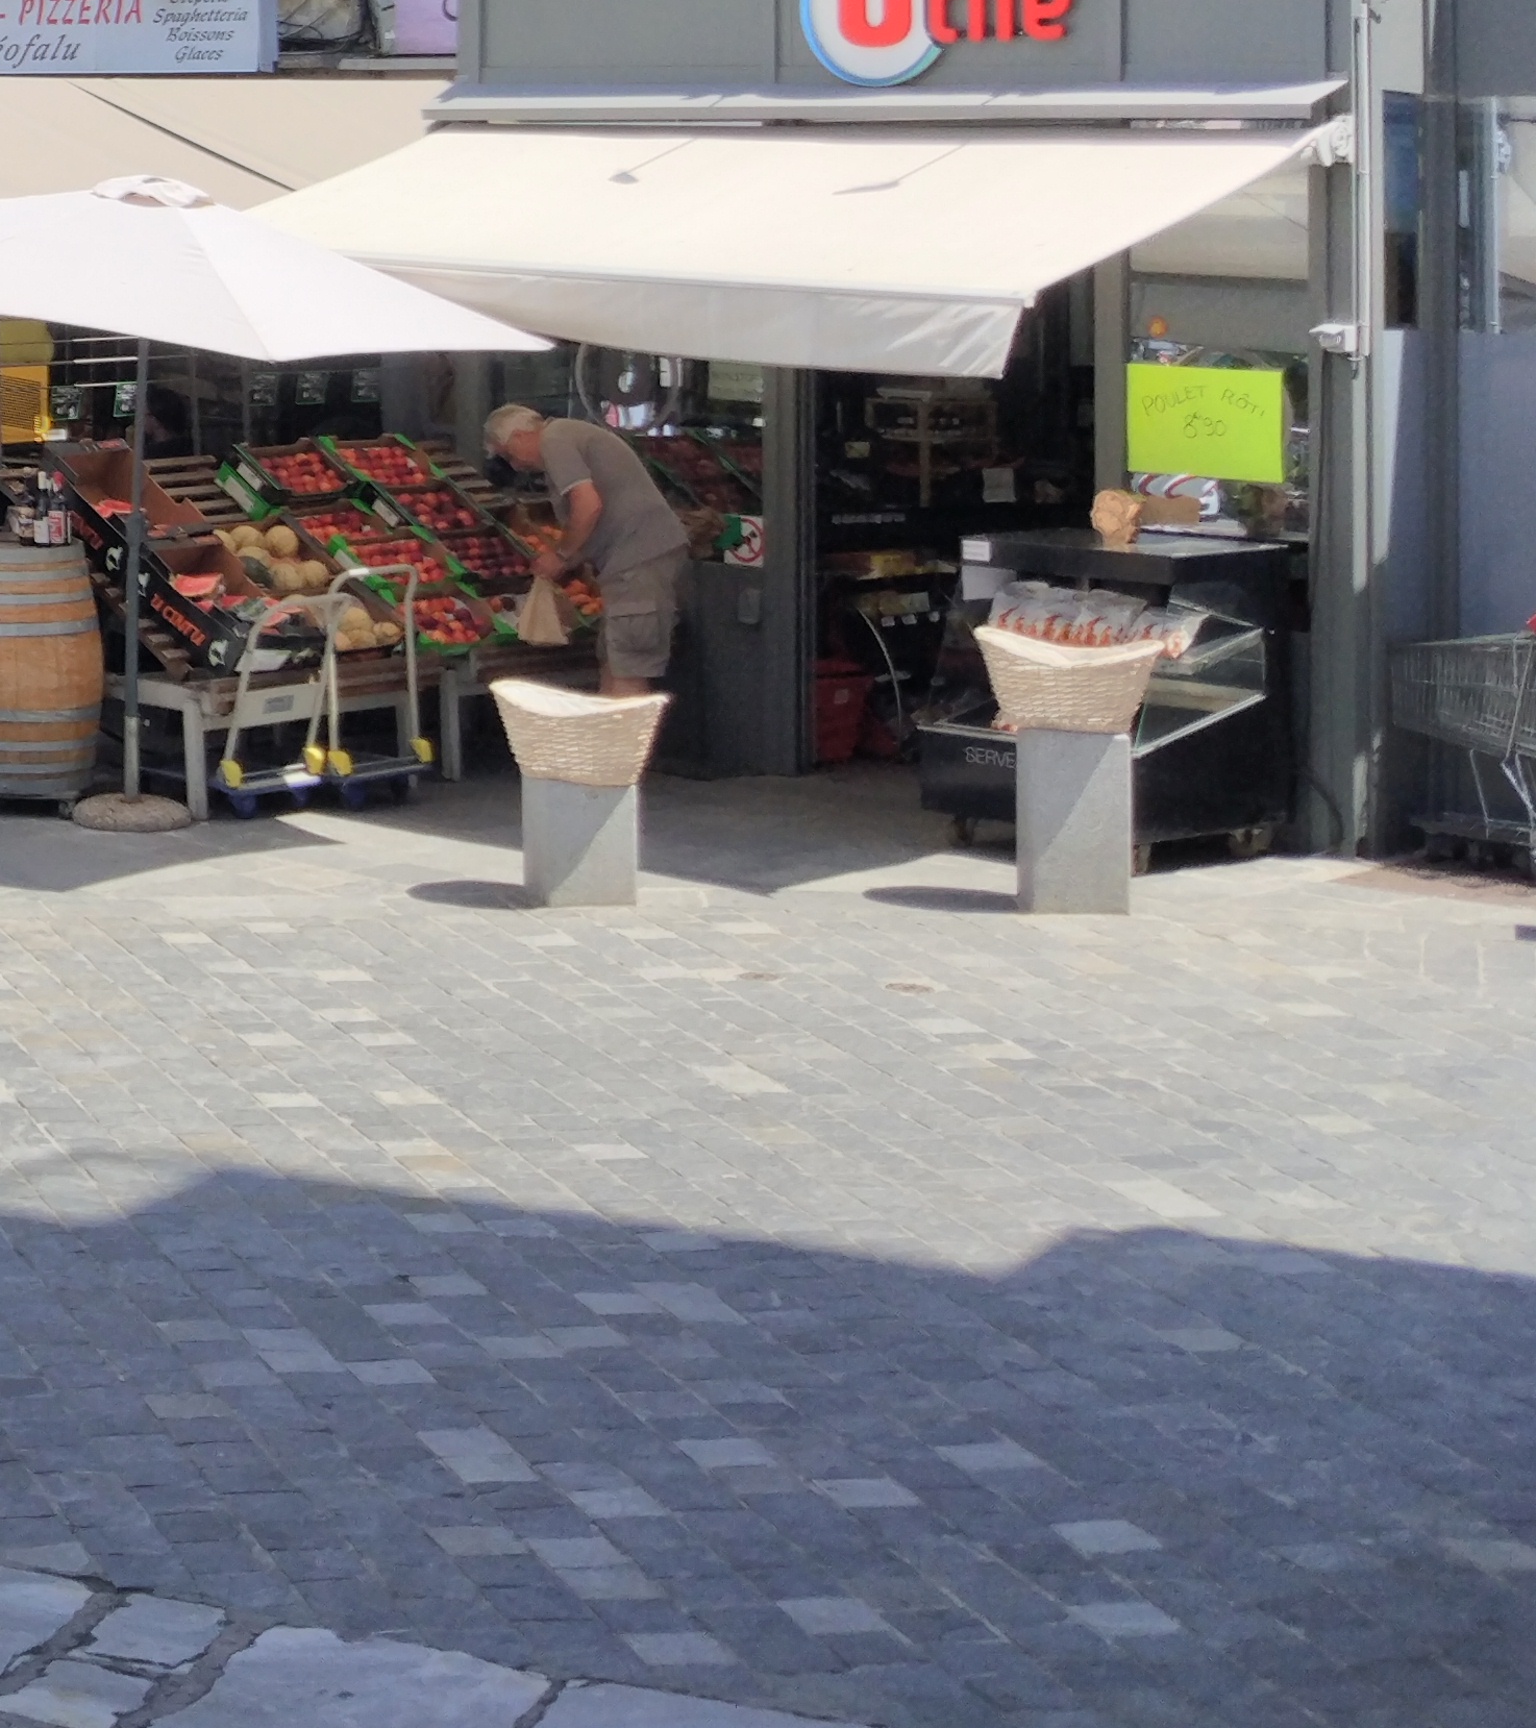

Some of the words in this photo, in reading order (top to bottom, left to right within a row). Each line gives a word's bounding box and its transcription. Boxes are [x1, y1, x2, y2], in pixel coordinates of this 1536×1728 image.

[174, 45, 225, 62] Glaces
[1141, 385, 1210, 417] POULET
[964, 746, 1017, 770] SERVE
